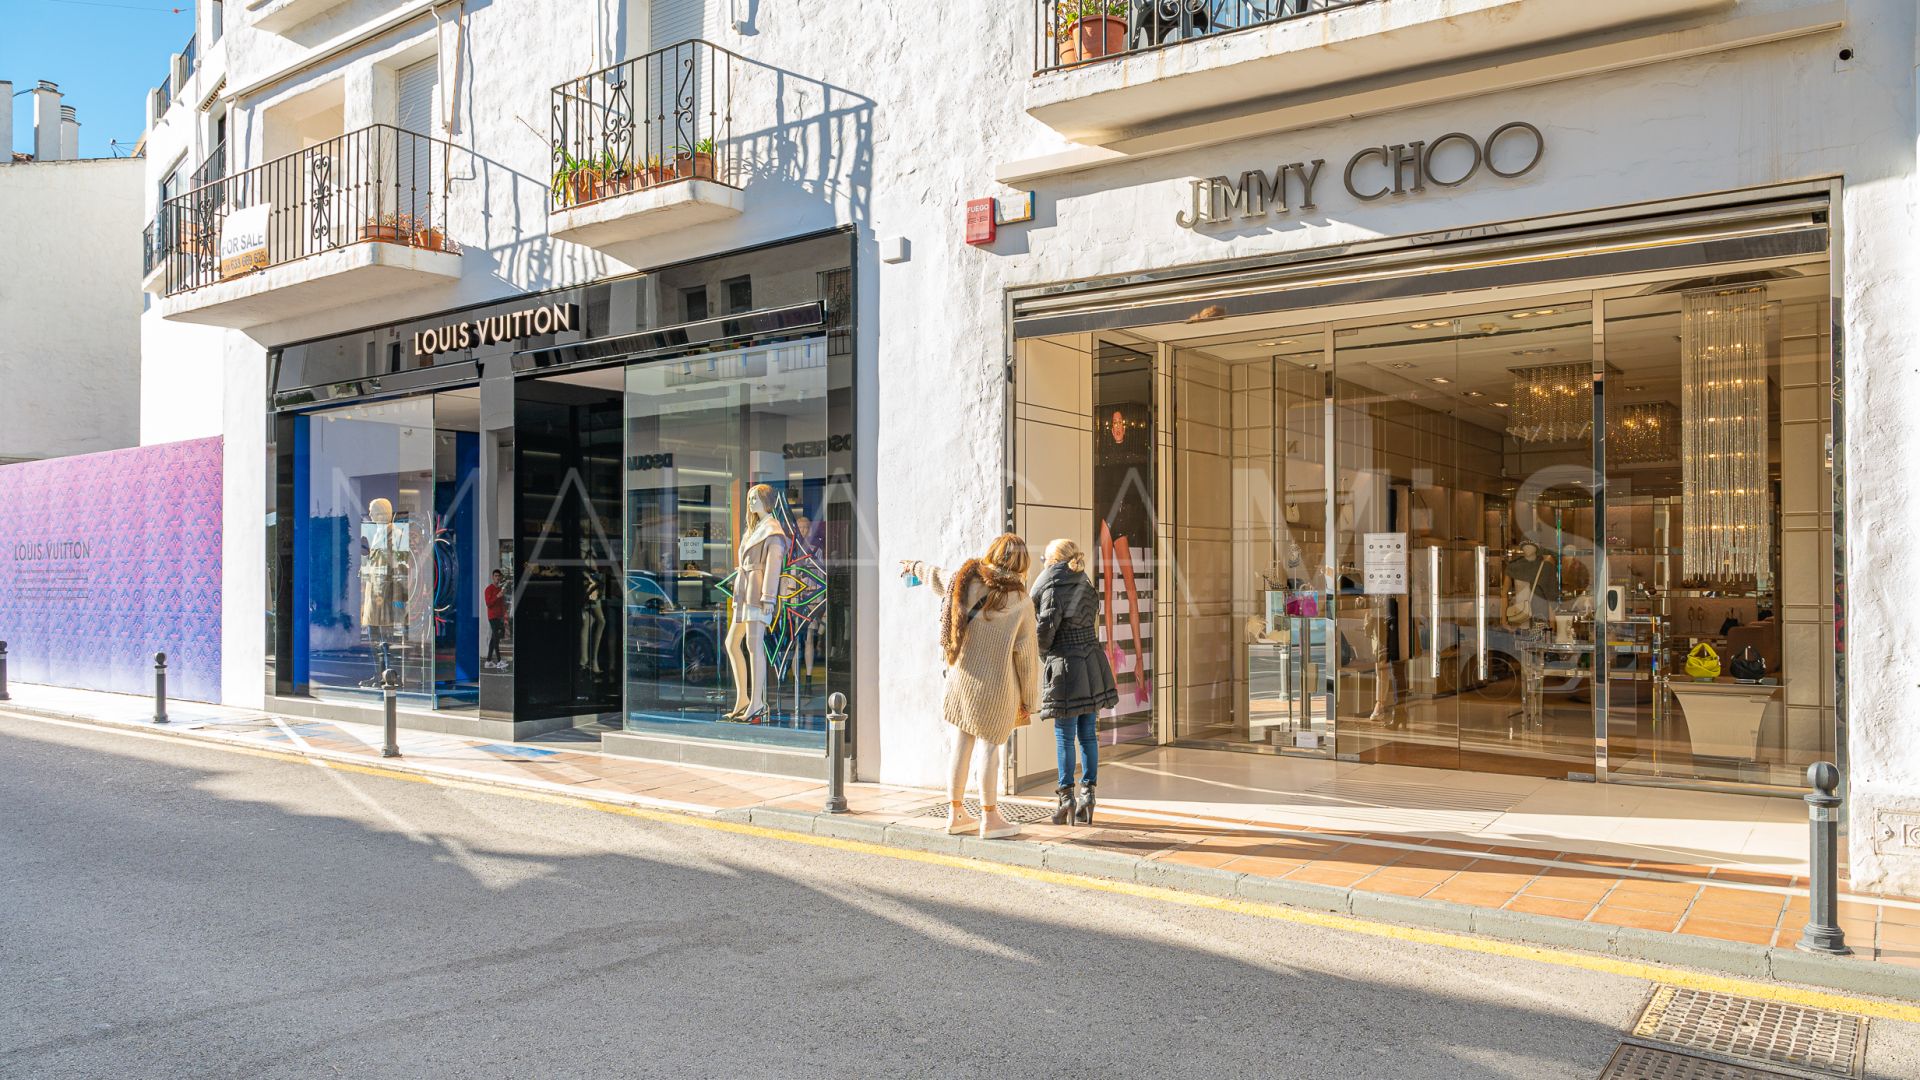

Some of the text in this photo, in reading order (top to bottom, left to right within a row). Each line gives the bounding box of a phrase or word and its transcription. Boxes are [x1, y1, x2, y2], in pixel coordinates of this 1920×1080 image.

[1175, 121, 1545, 229] JIMMY CHOO
[967, 203, 989, 214] FUEGO
[222, 232, 264, 256] FOR SALE
[254, 250, 267, 264] 625
[415, 302, 570, 356] LOUIS VUITTON
[14, 540, 90, 561] LOUIS VUITTON
